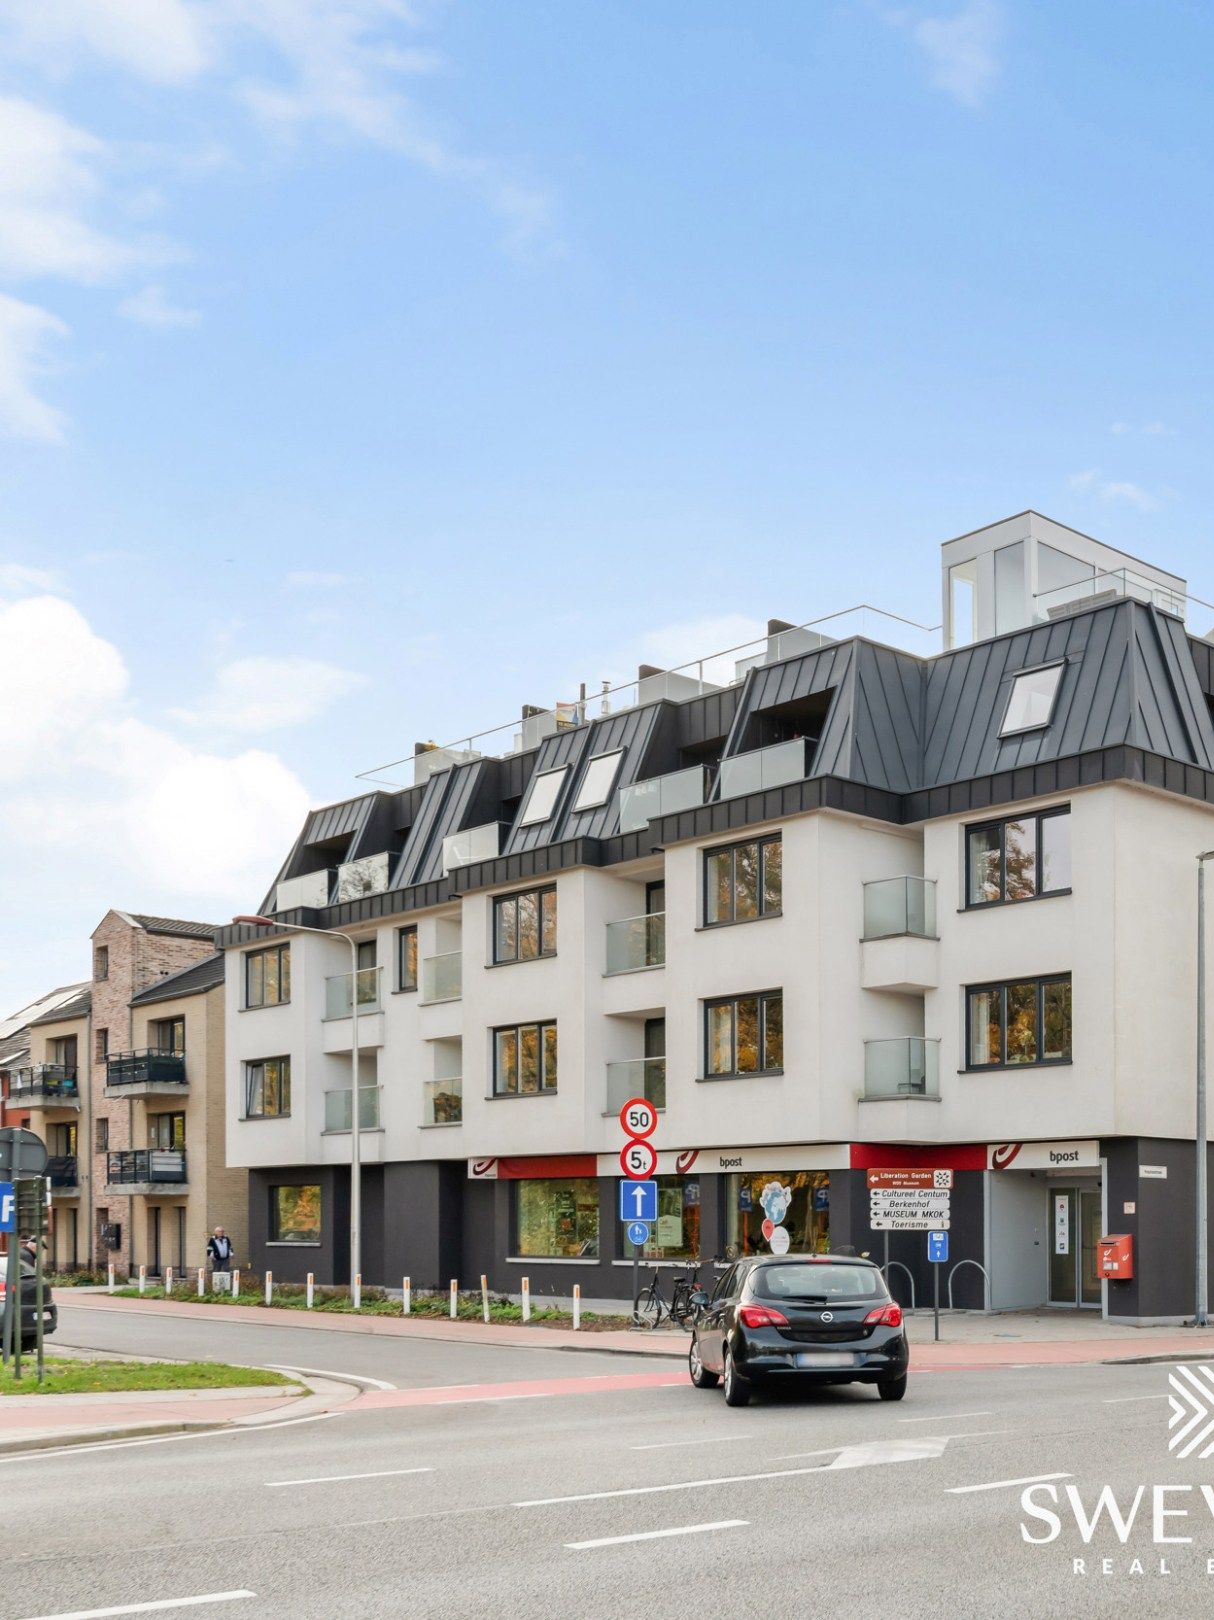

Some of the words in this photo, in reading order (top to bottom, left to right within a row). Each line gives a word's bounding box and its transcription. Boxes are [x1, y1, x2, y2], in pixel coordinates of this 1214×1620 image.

[630, 1111, 649, 1128] 50
[630, 1151, 642, 1170] 5
[720, 1157, 742, 1169] bpost
[1049, 1150, 1079, 1164] bpost
